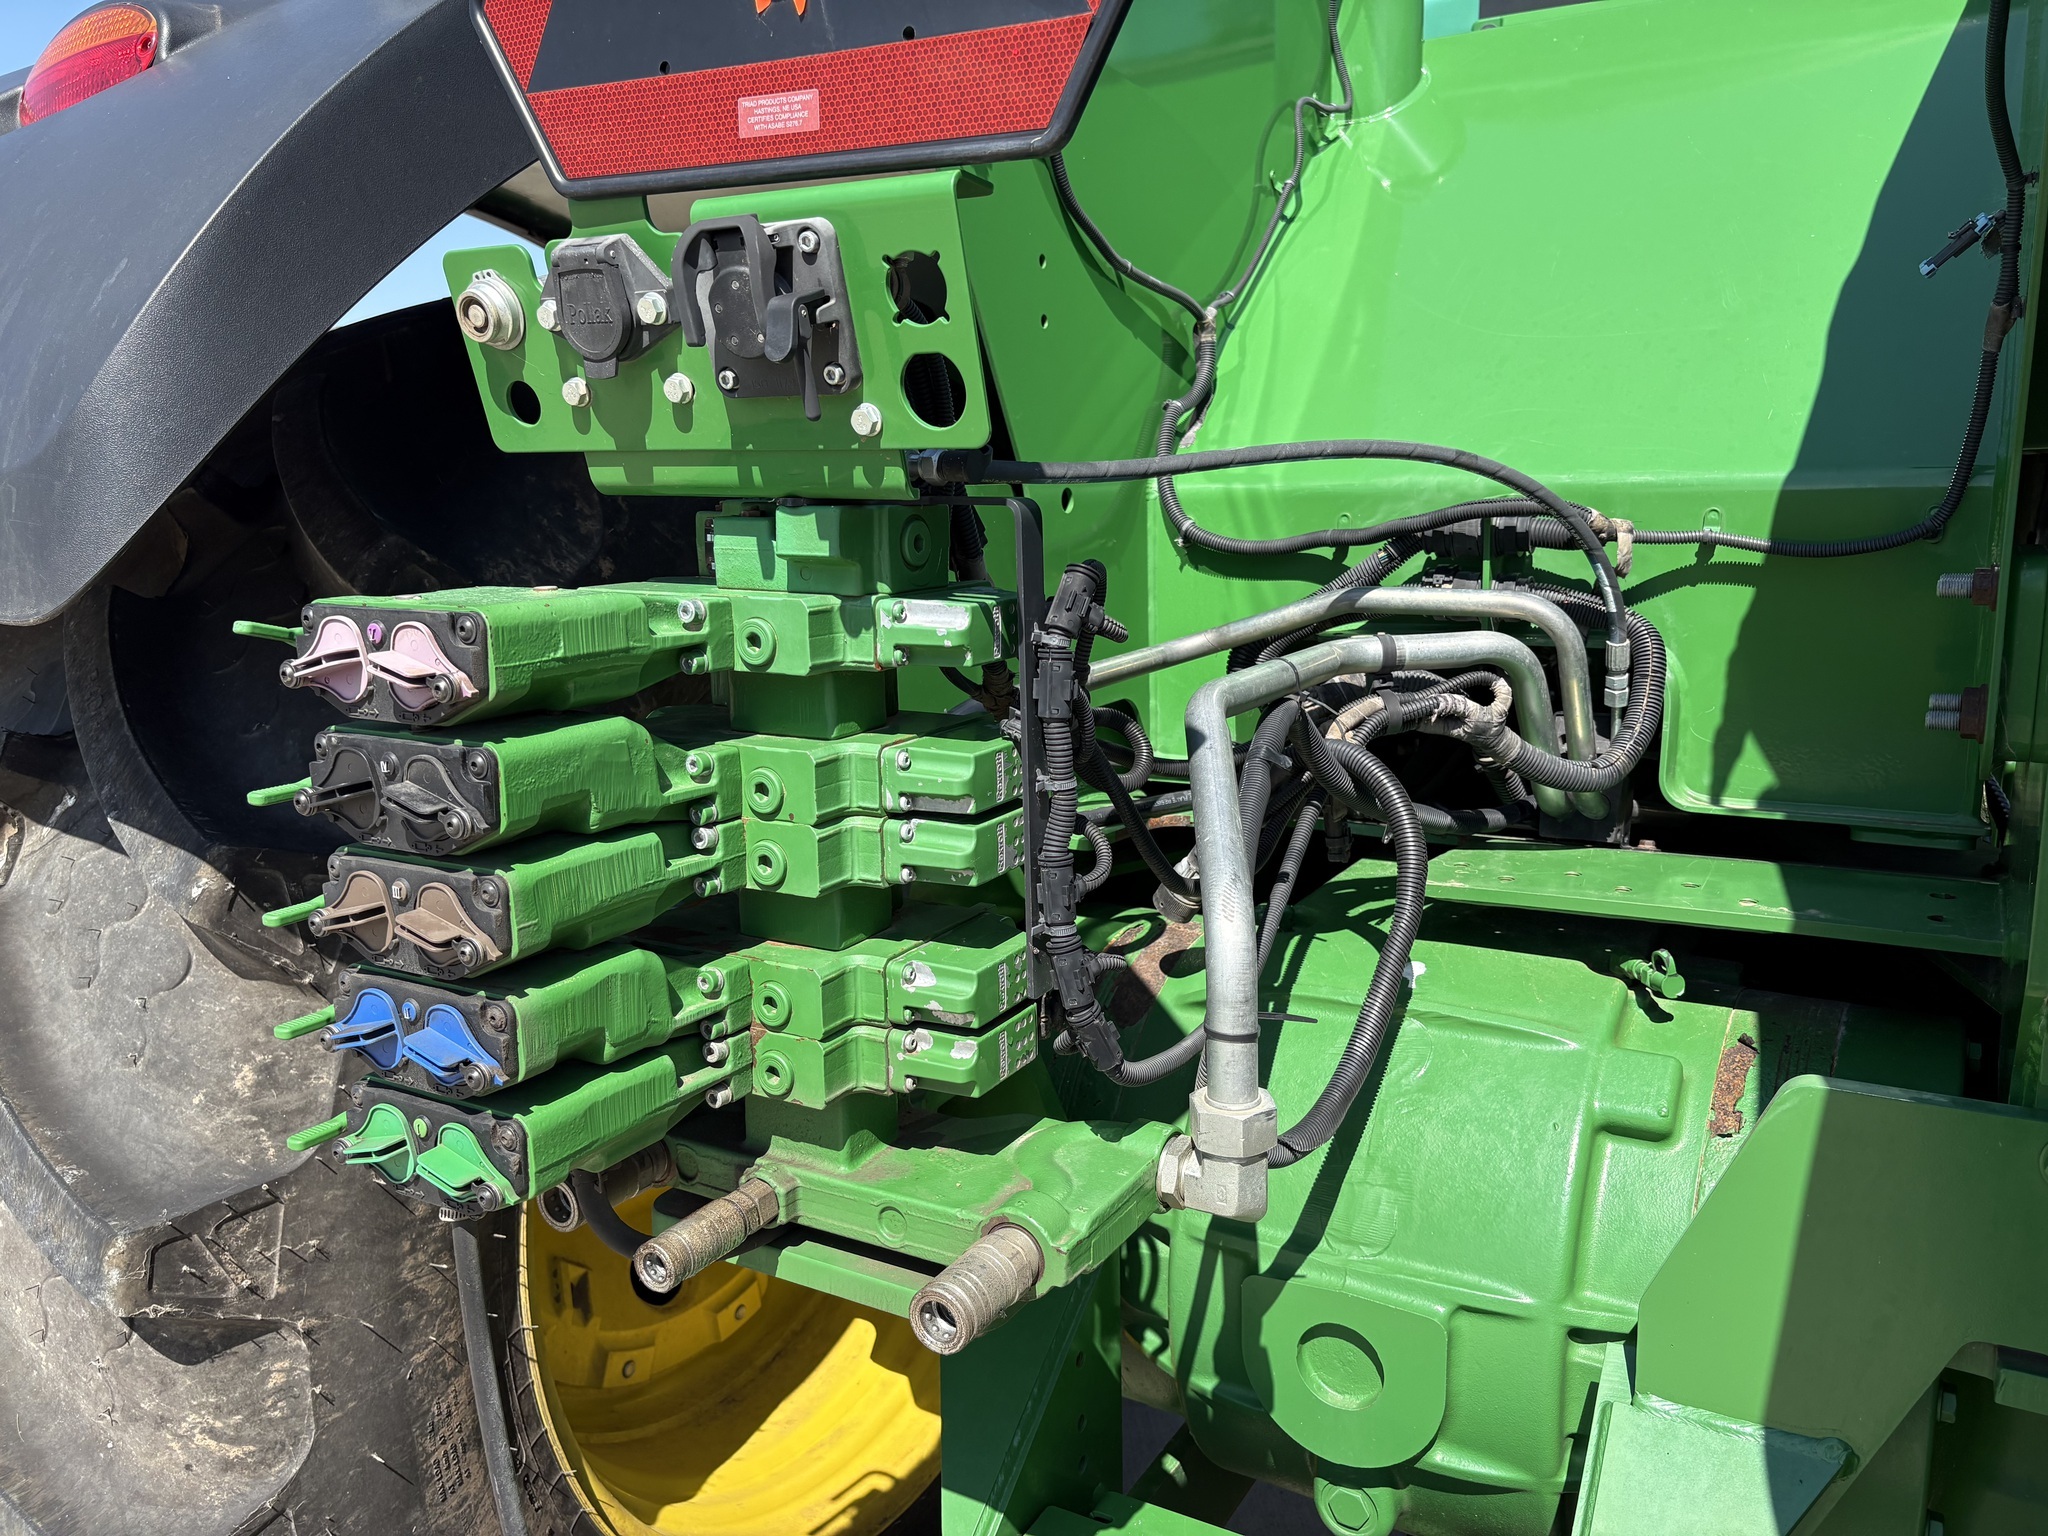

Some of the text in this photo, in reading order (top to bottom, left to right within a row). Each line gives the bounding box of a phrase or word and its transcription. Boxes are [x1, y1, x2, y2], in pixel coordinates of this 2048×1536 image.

[758, 97, 787, 106] PRODUCTS
[788, 94, 813, 103] COMPANY
[748, 111, 809, 124] CERTIFIES COMPLIANCE
[754, 106, 781, 115] HASTINGS,
[566, 302, 613, 326] Pollak
[998, 963, 1006, 1011] Rexroth
[999, 1030, 1007, 1080] Rexroth
